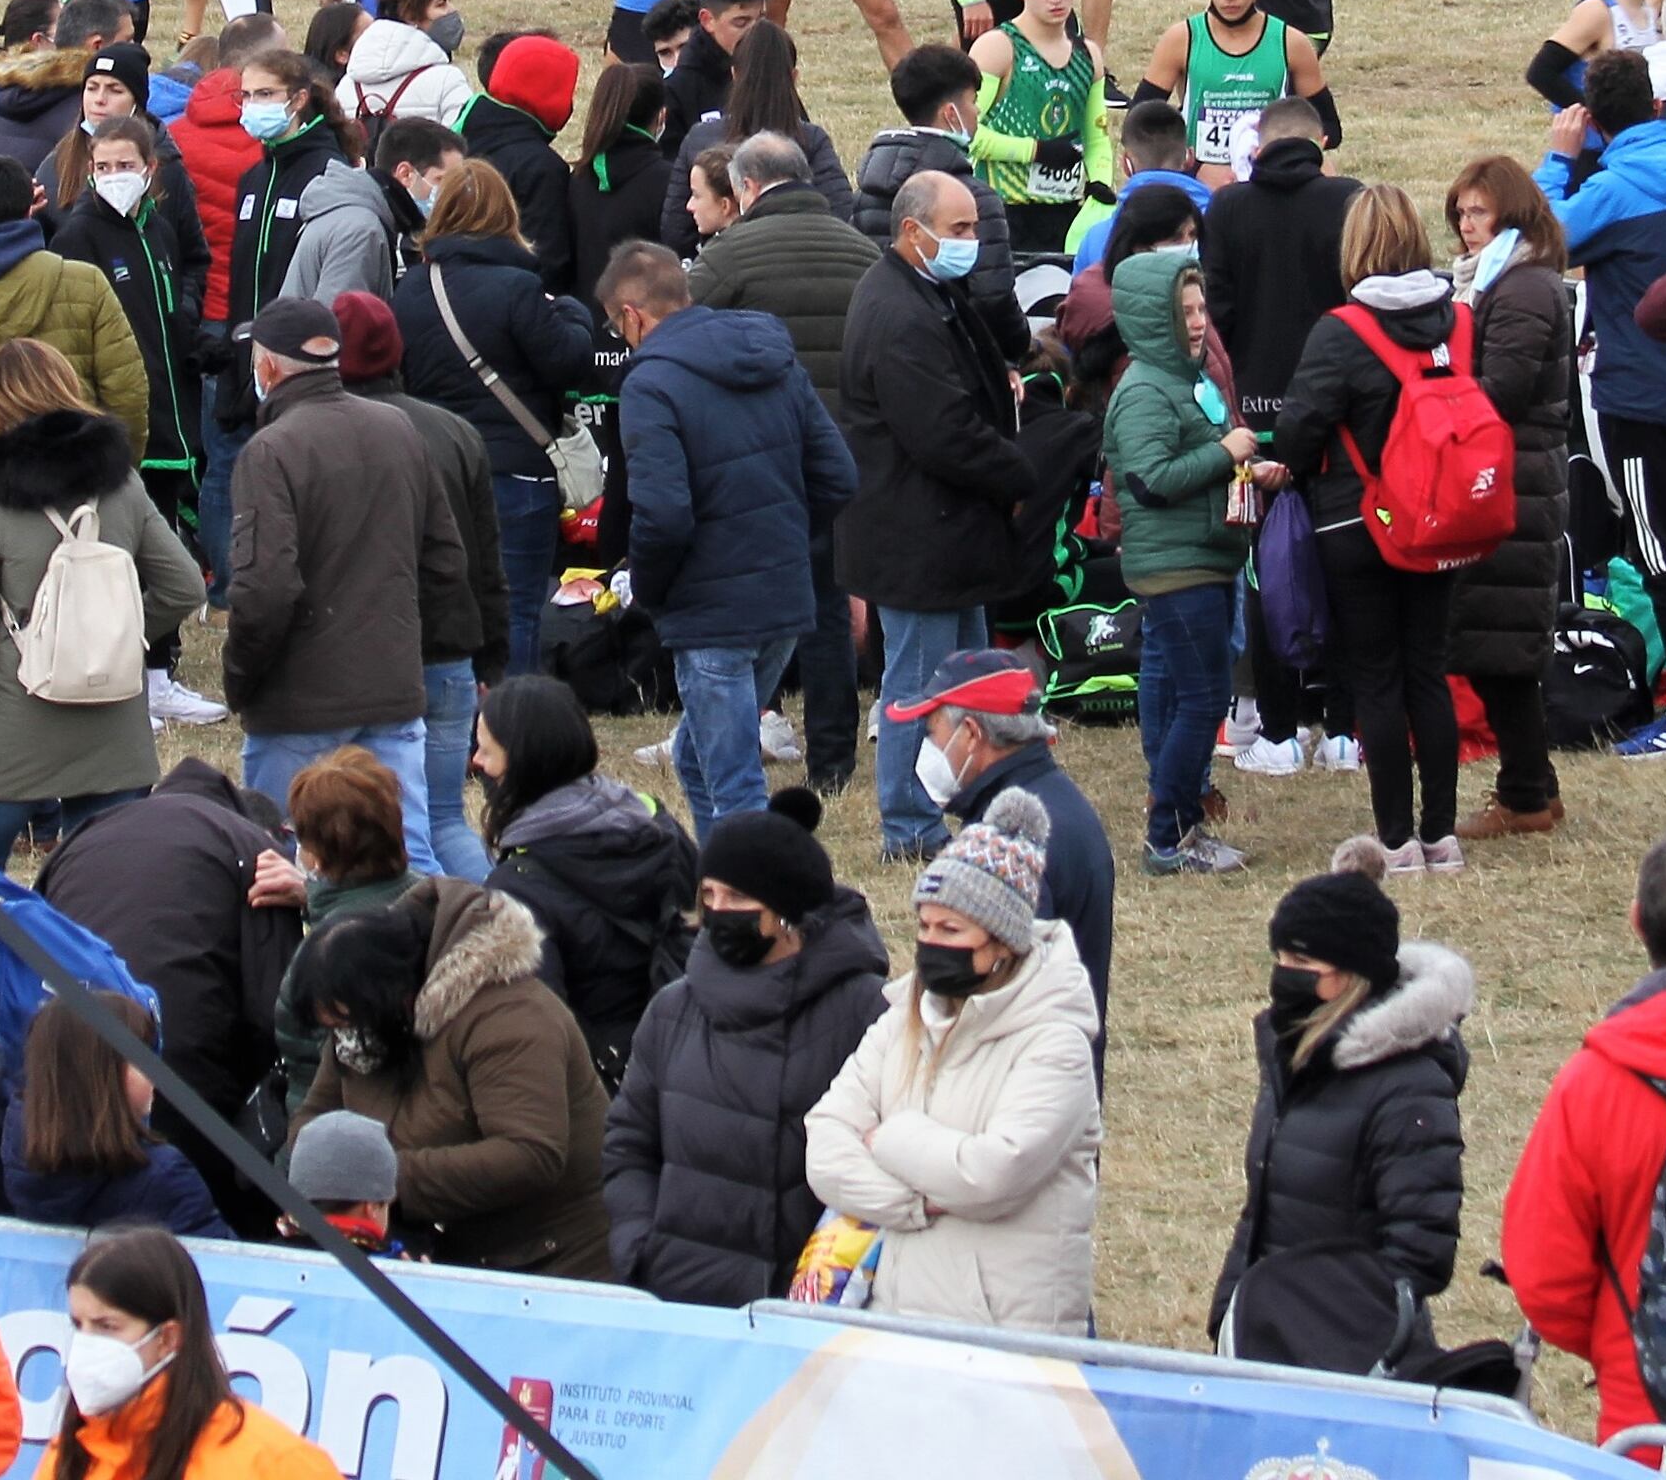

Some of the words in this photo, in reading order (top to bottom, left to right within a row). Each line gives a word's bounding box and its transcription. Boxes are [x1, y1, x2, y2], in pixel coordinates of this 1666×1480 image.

[594, 347, 630, 366] mad
[1241, 394, 1283, 414] Extre
[560, 1382, 622, 1404] INSTITUTO
[627, 1388, 696, 1412] PROVINCIAL
[557, 1405, 589, 1421] PARA
[595, 1408, 608, 1426] EL
[614, 1410, 667, 1431] DEPORTE
